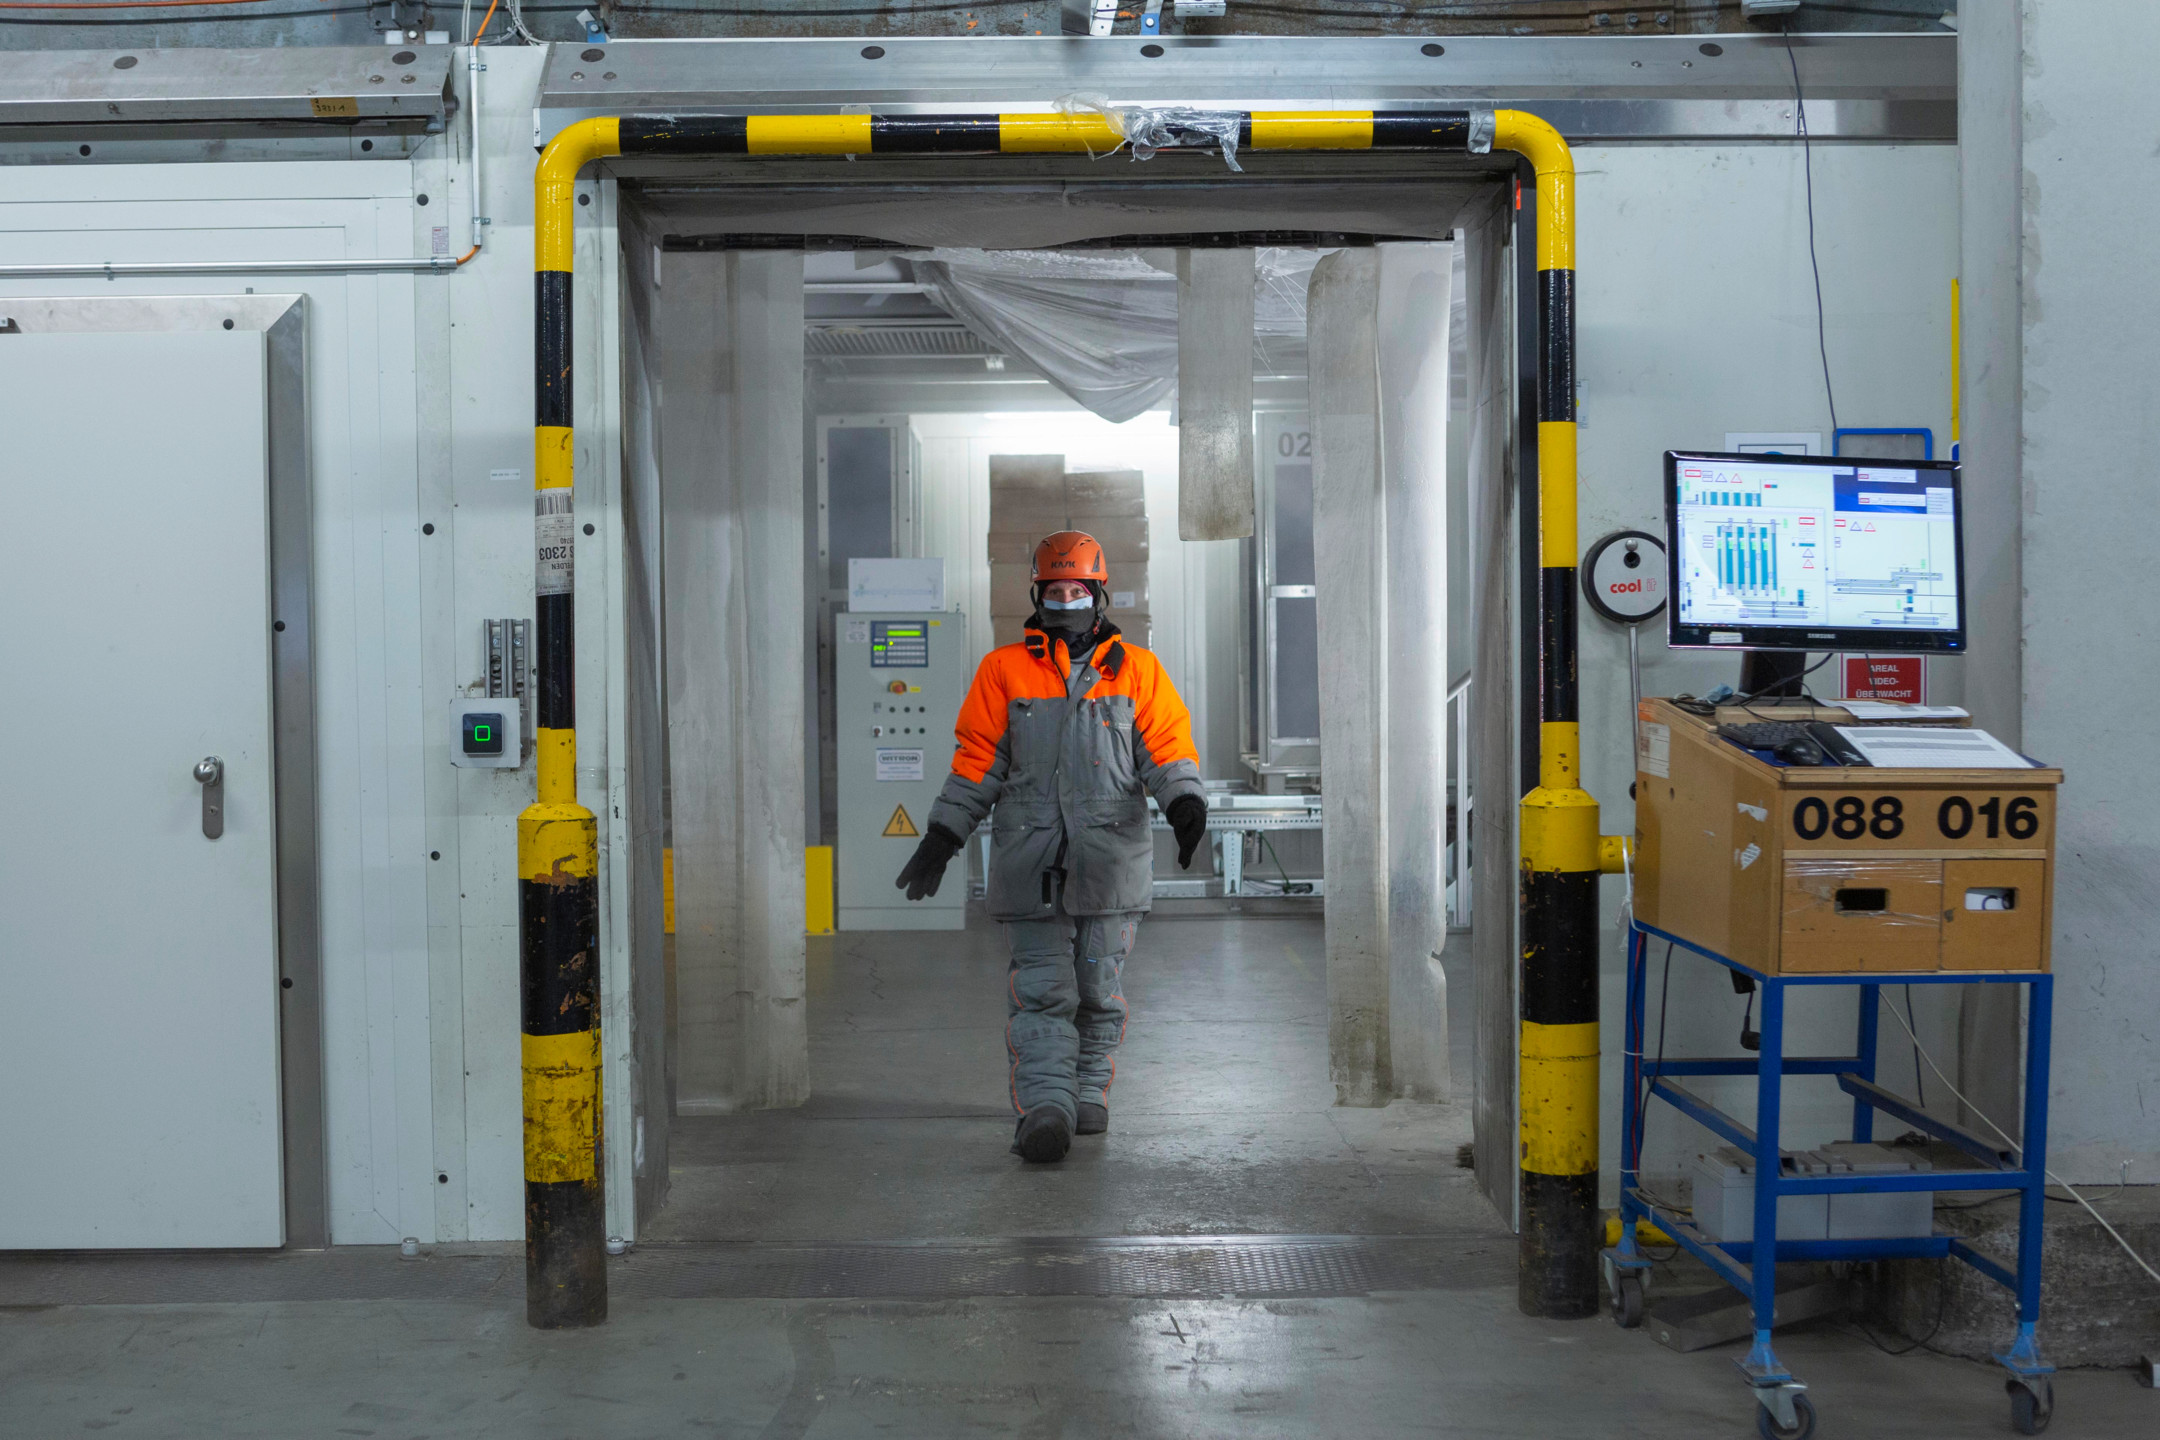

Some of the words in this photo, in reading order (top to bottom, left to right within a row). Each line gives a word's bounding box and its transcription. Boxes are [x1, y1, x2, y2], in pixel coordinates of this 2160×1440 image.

[1278, 432, 1312, 457] 02
[539, 546, 567, 560] 2303
[1610, 579, 1642, 593] cool
[1869, 664, 1899, 673] AREAL
[1855, 688, 1913, 698] ÜBERWACHT
[1793, 796, 1904, 840] 088
[1937, 796, 2039, 839] 016
